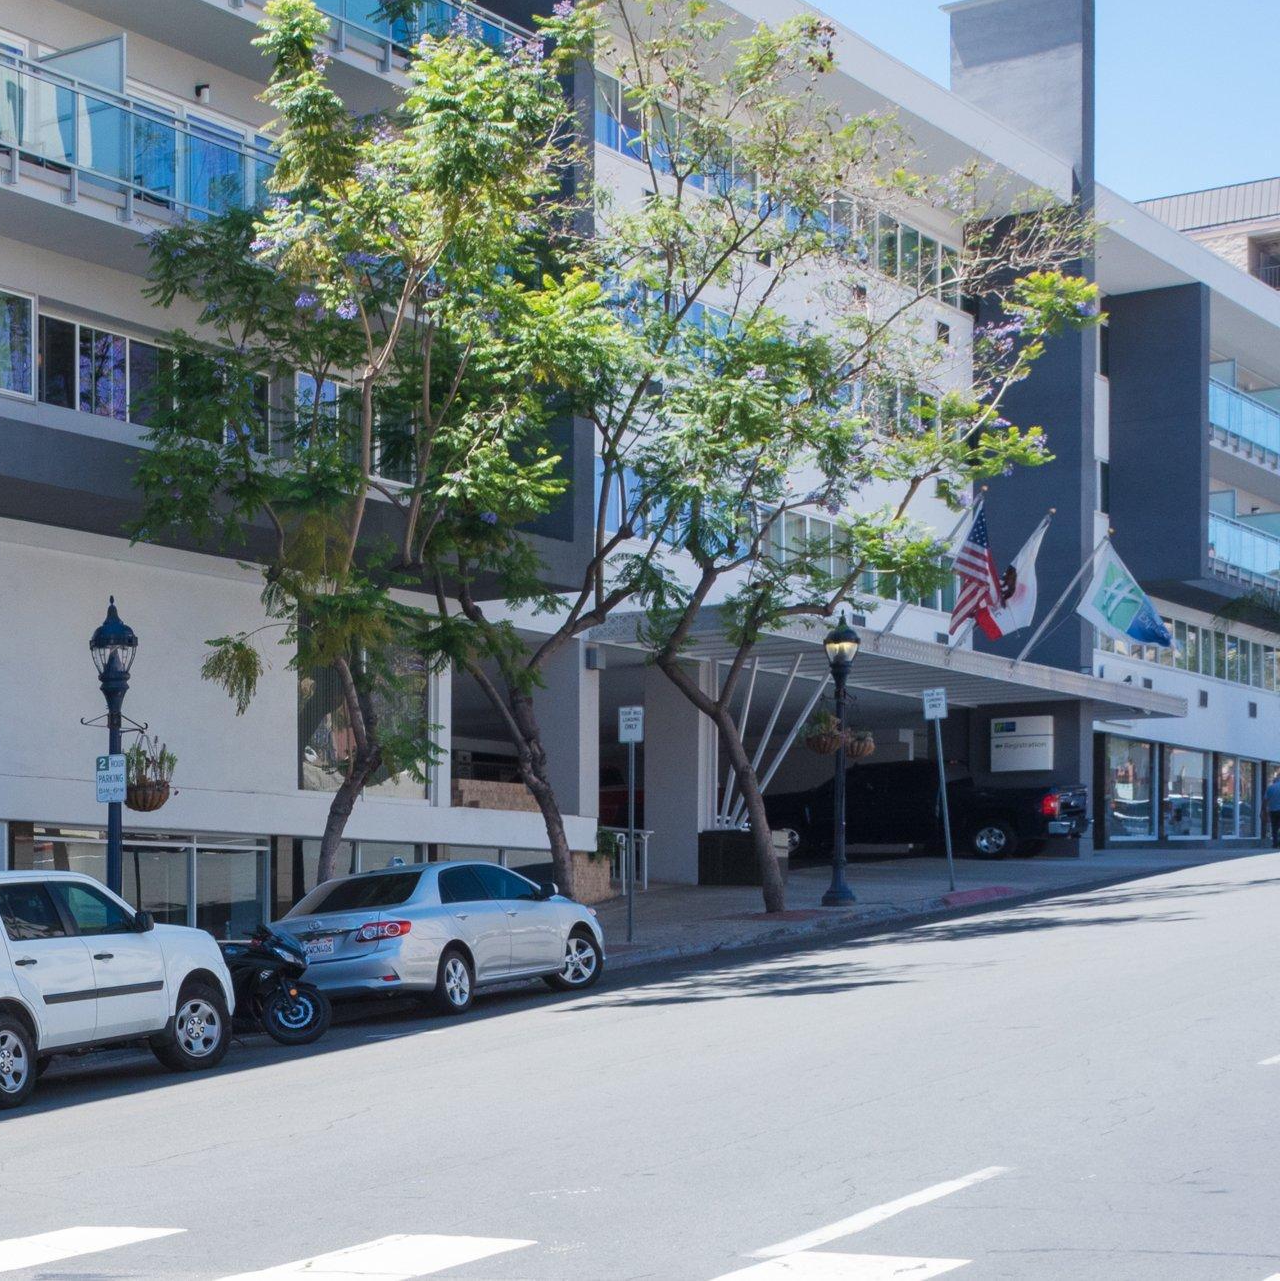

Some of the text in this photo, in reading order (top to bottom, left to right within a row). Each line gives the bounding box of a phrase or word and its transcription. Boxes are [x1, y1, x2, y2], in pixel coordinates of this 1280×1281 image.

[1004, 742, 1047, 750] Registration
[99, 758, 124, 769] 2 HOUR
[98, 774, 124, 783] PARKING
